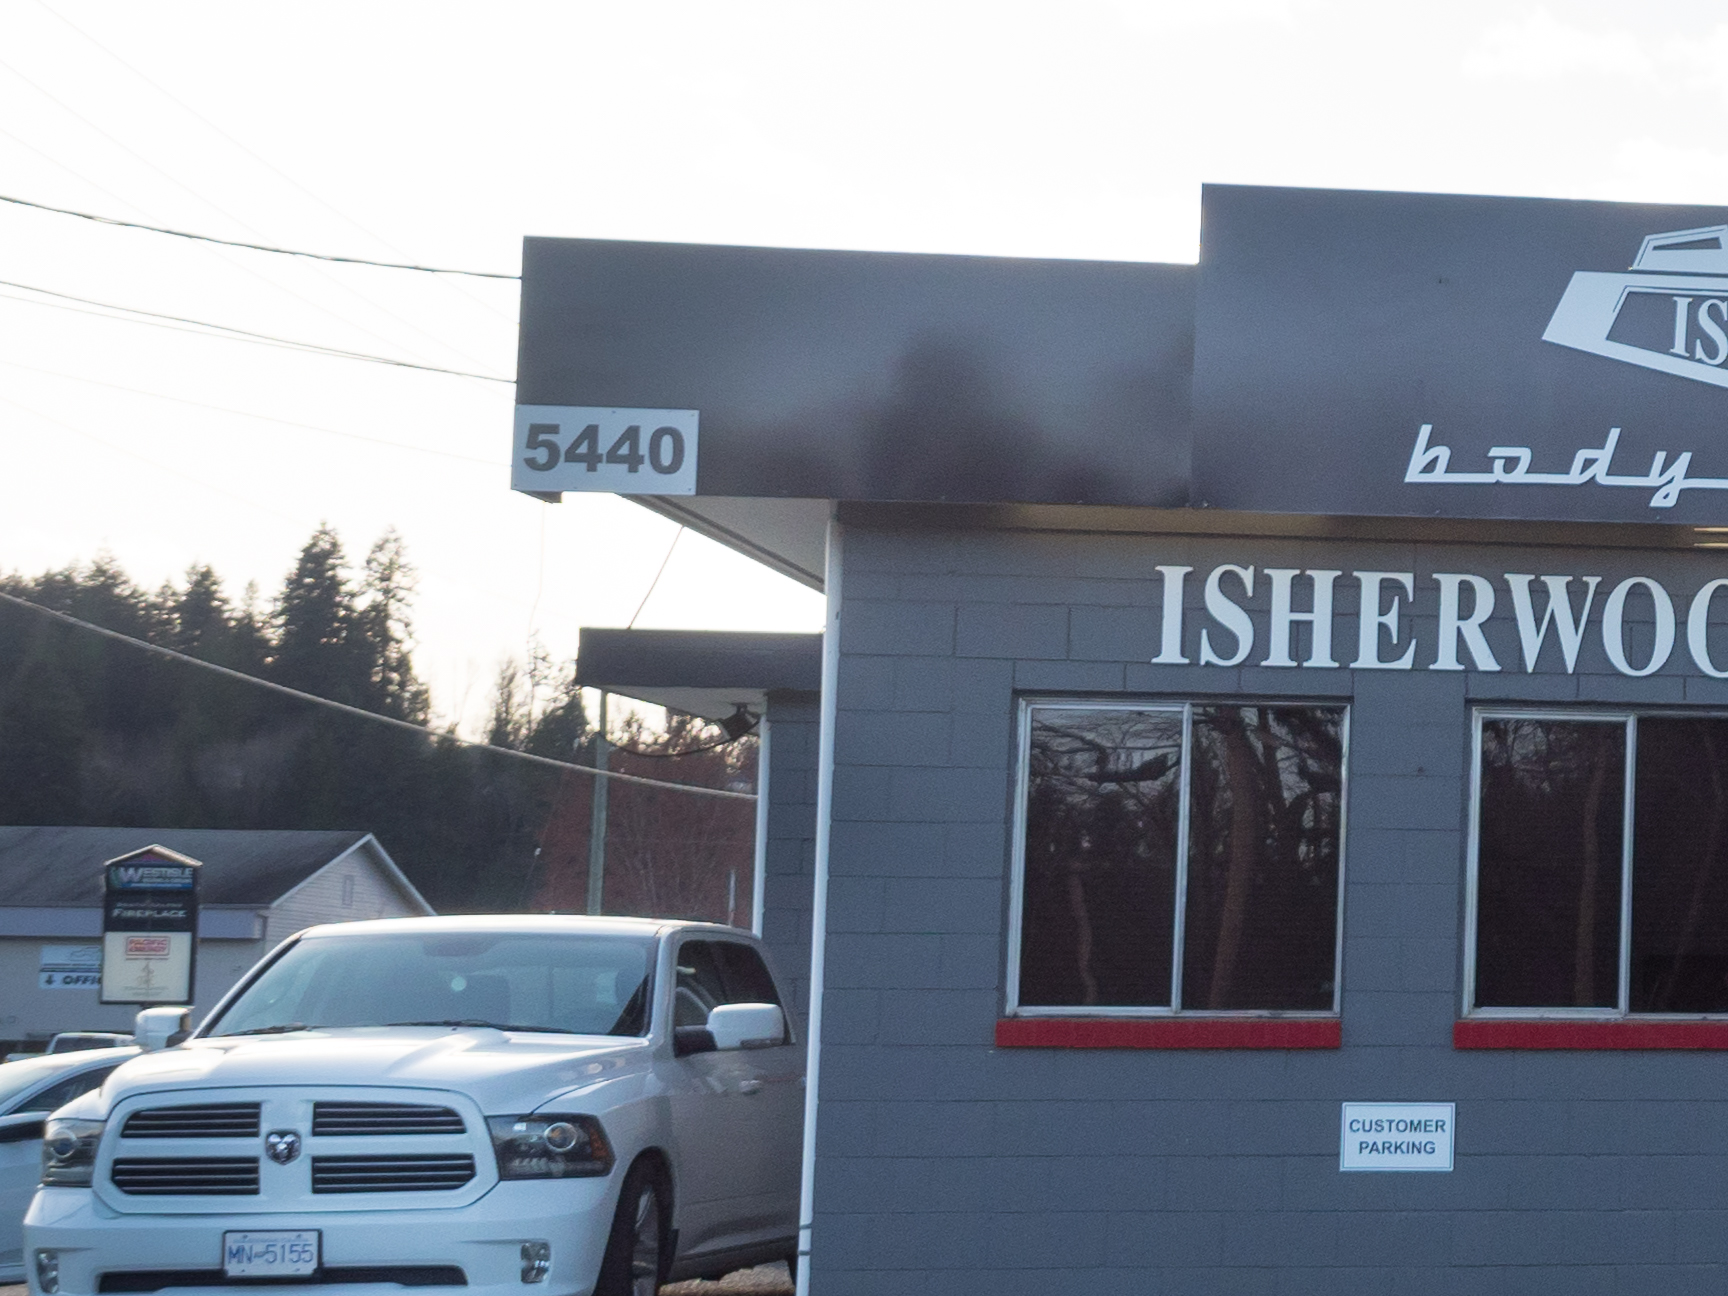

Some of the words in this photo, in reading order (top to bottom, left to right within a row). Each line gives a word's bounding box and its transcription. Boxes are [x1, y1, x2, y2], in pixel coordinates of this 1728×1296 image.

[523, 423, 685, 475] 5440
[1349, 1119, 1446, 1133] CUSTOMER
[1358, 1140, 1436, 1154] PARKING
